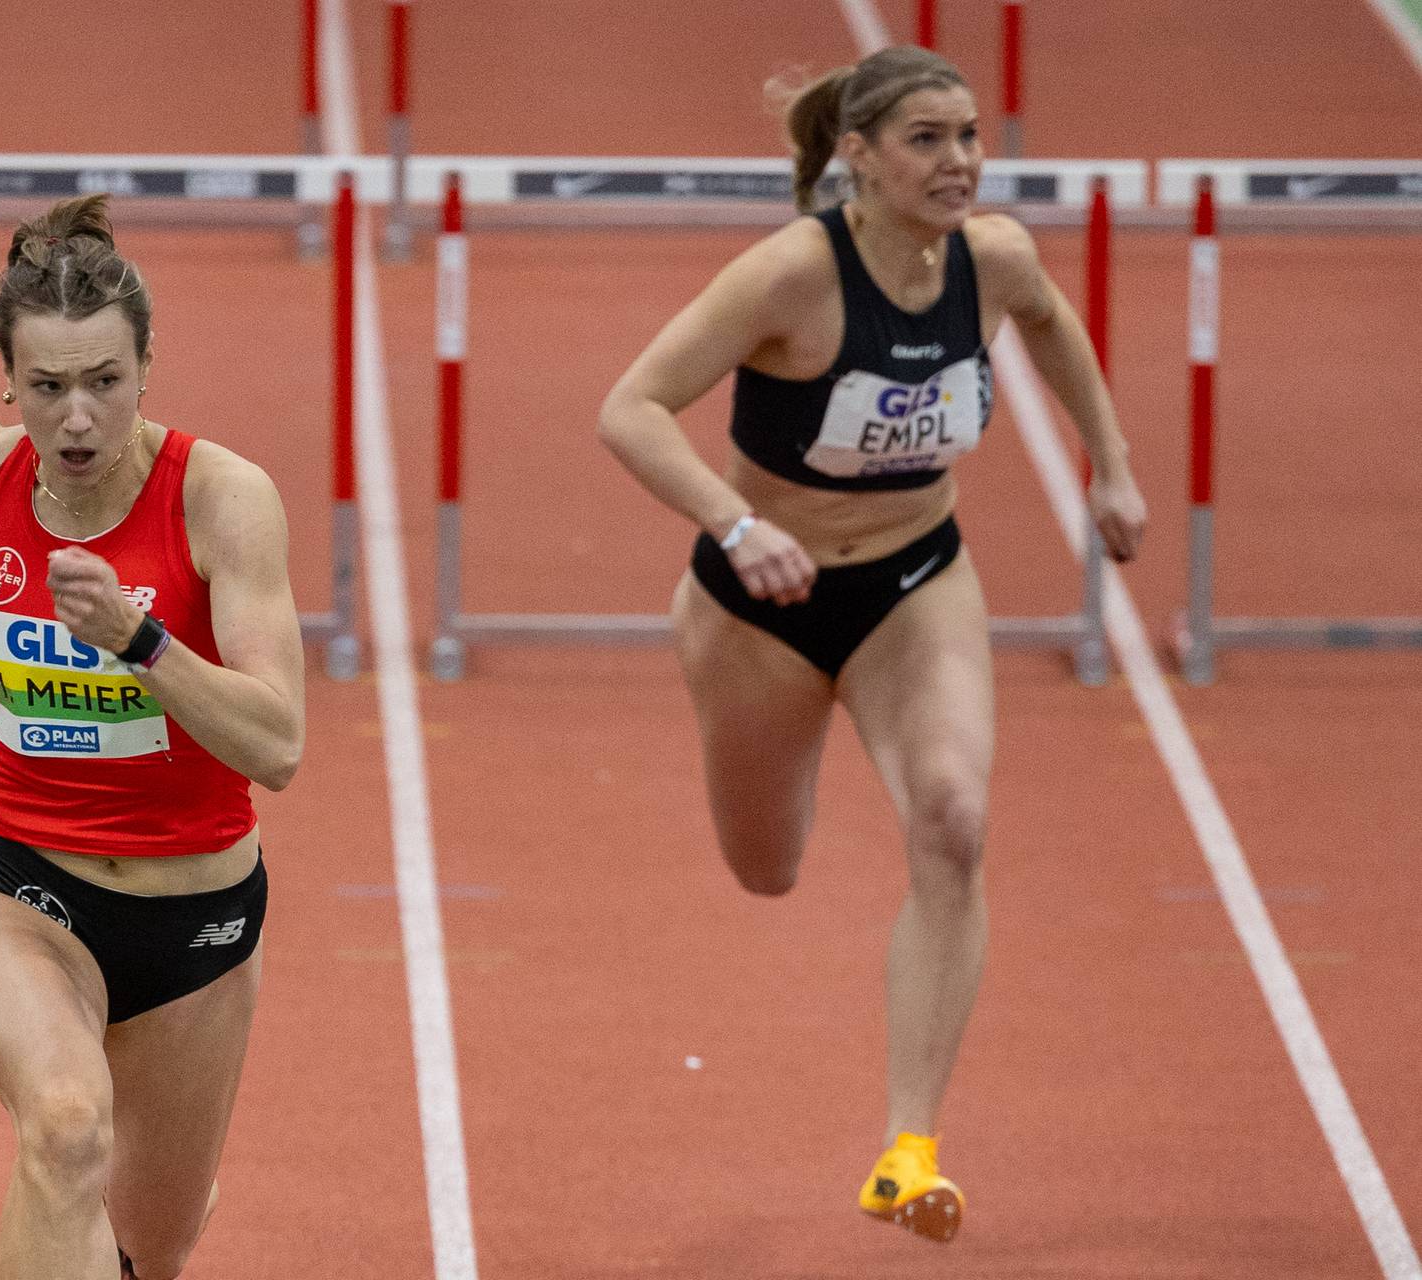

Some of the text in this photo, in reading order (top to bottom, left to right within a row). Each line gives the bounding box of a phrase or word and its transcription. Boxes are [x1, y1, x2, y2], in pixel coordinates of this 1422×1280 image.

[859, 411, 953, 453] EMPL
[26, 677, 147, 715] MEIER
[52, 729, 96, 744] PLAN
